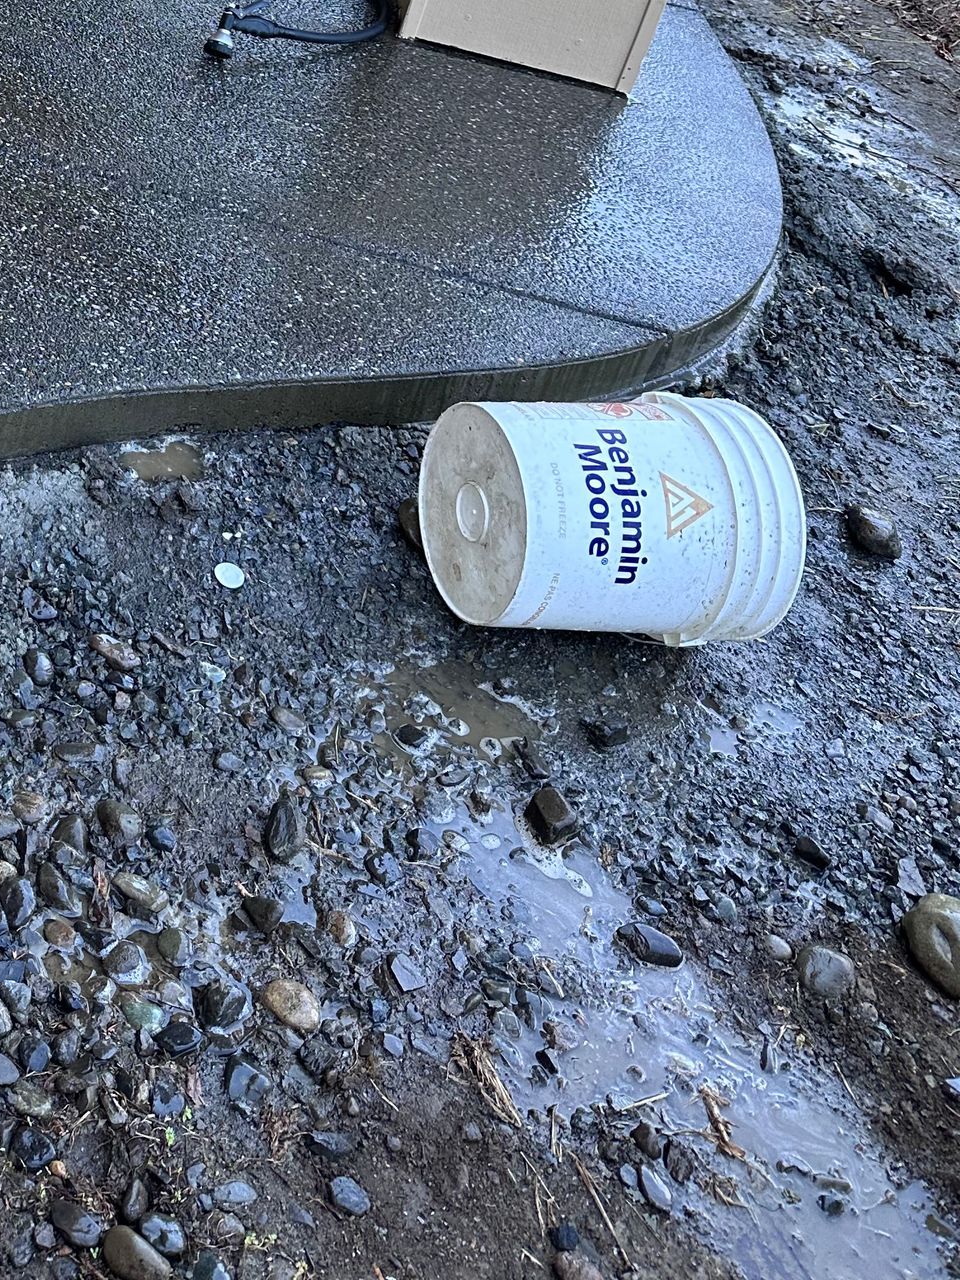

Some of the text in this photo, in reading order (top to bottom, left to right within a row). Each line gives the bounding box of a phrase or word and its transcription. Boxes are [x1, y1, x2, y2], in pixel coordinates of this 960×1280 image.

[550, 462, 567, 539] DO NOT FREEZE
[595, 428, 648, 585] Benjamin
[551, 572, 561, 585] NE
